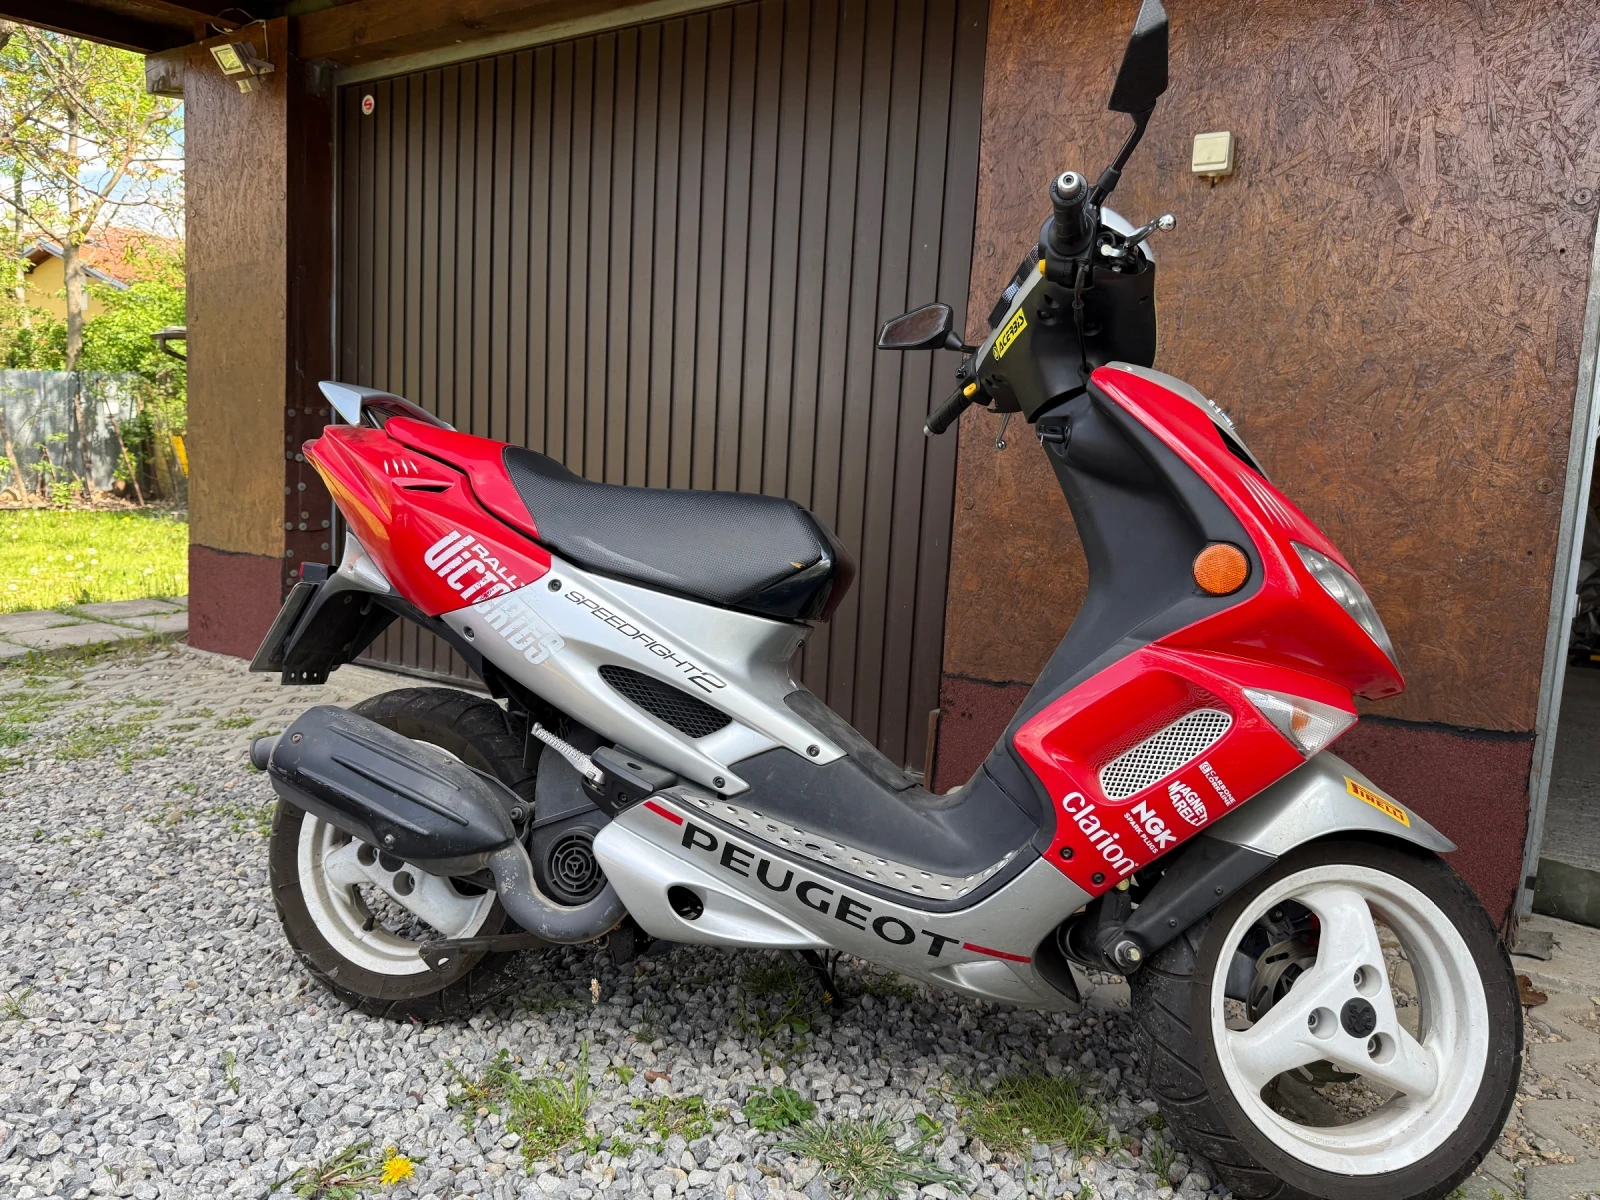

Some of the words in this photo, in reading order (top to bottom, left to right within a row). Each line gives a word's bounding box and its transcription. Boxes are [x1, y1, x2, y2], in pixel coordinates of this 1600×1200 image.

[1168, 780, 1208, 823] MAGNETI
[1168, 784, 1206, 827] MARELLI
[1205, 773, 1232, 807] LORRAINE
[1210, 770, 1237, 804] CARBONE
[1062, 791, 1135, 876] Clarion
[1123, 812, 1144, 835] SPARK
[1141, 833, 1159, 854] PLUGS
[1130, 800, 1177, 849] NGK
[681, 822, 960, 958] PEUGEOT
